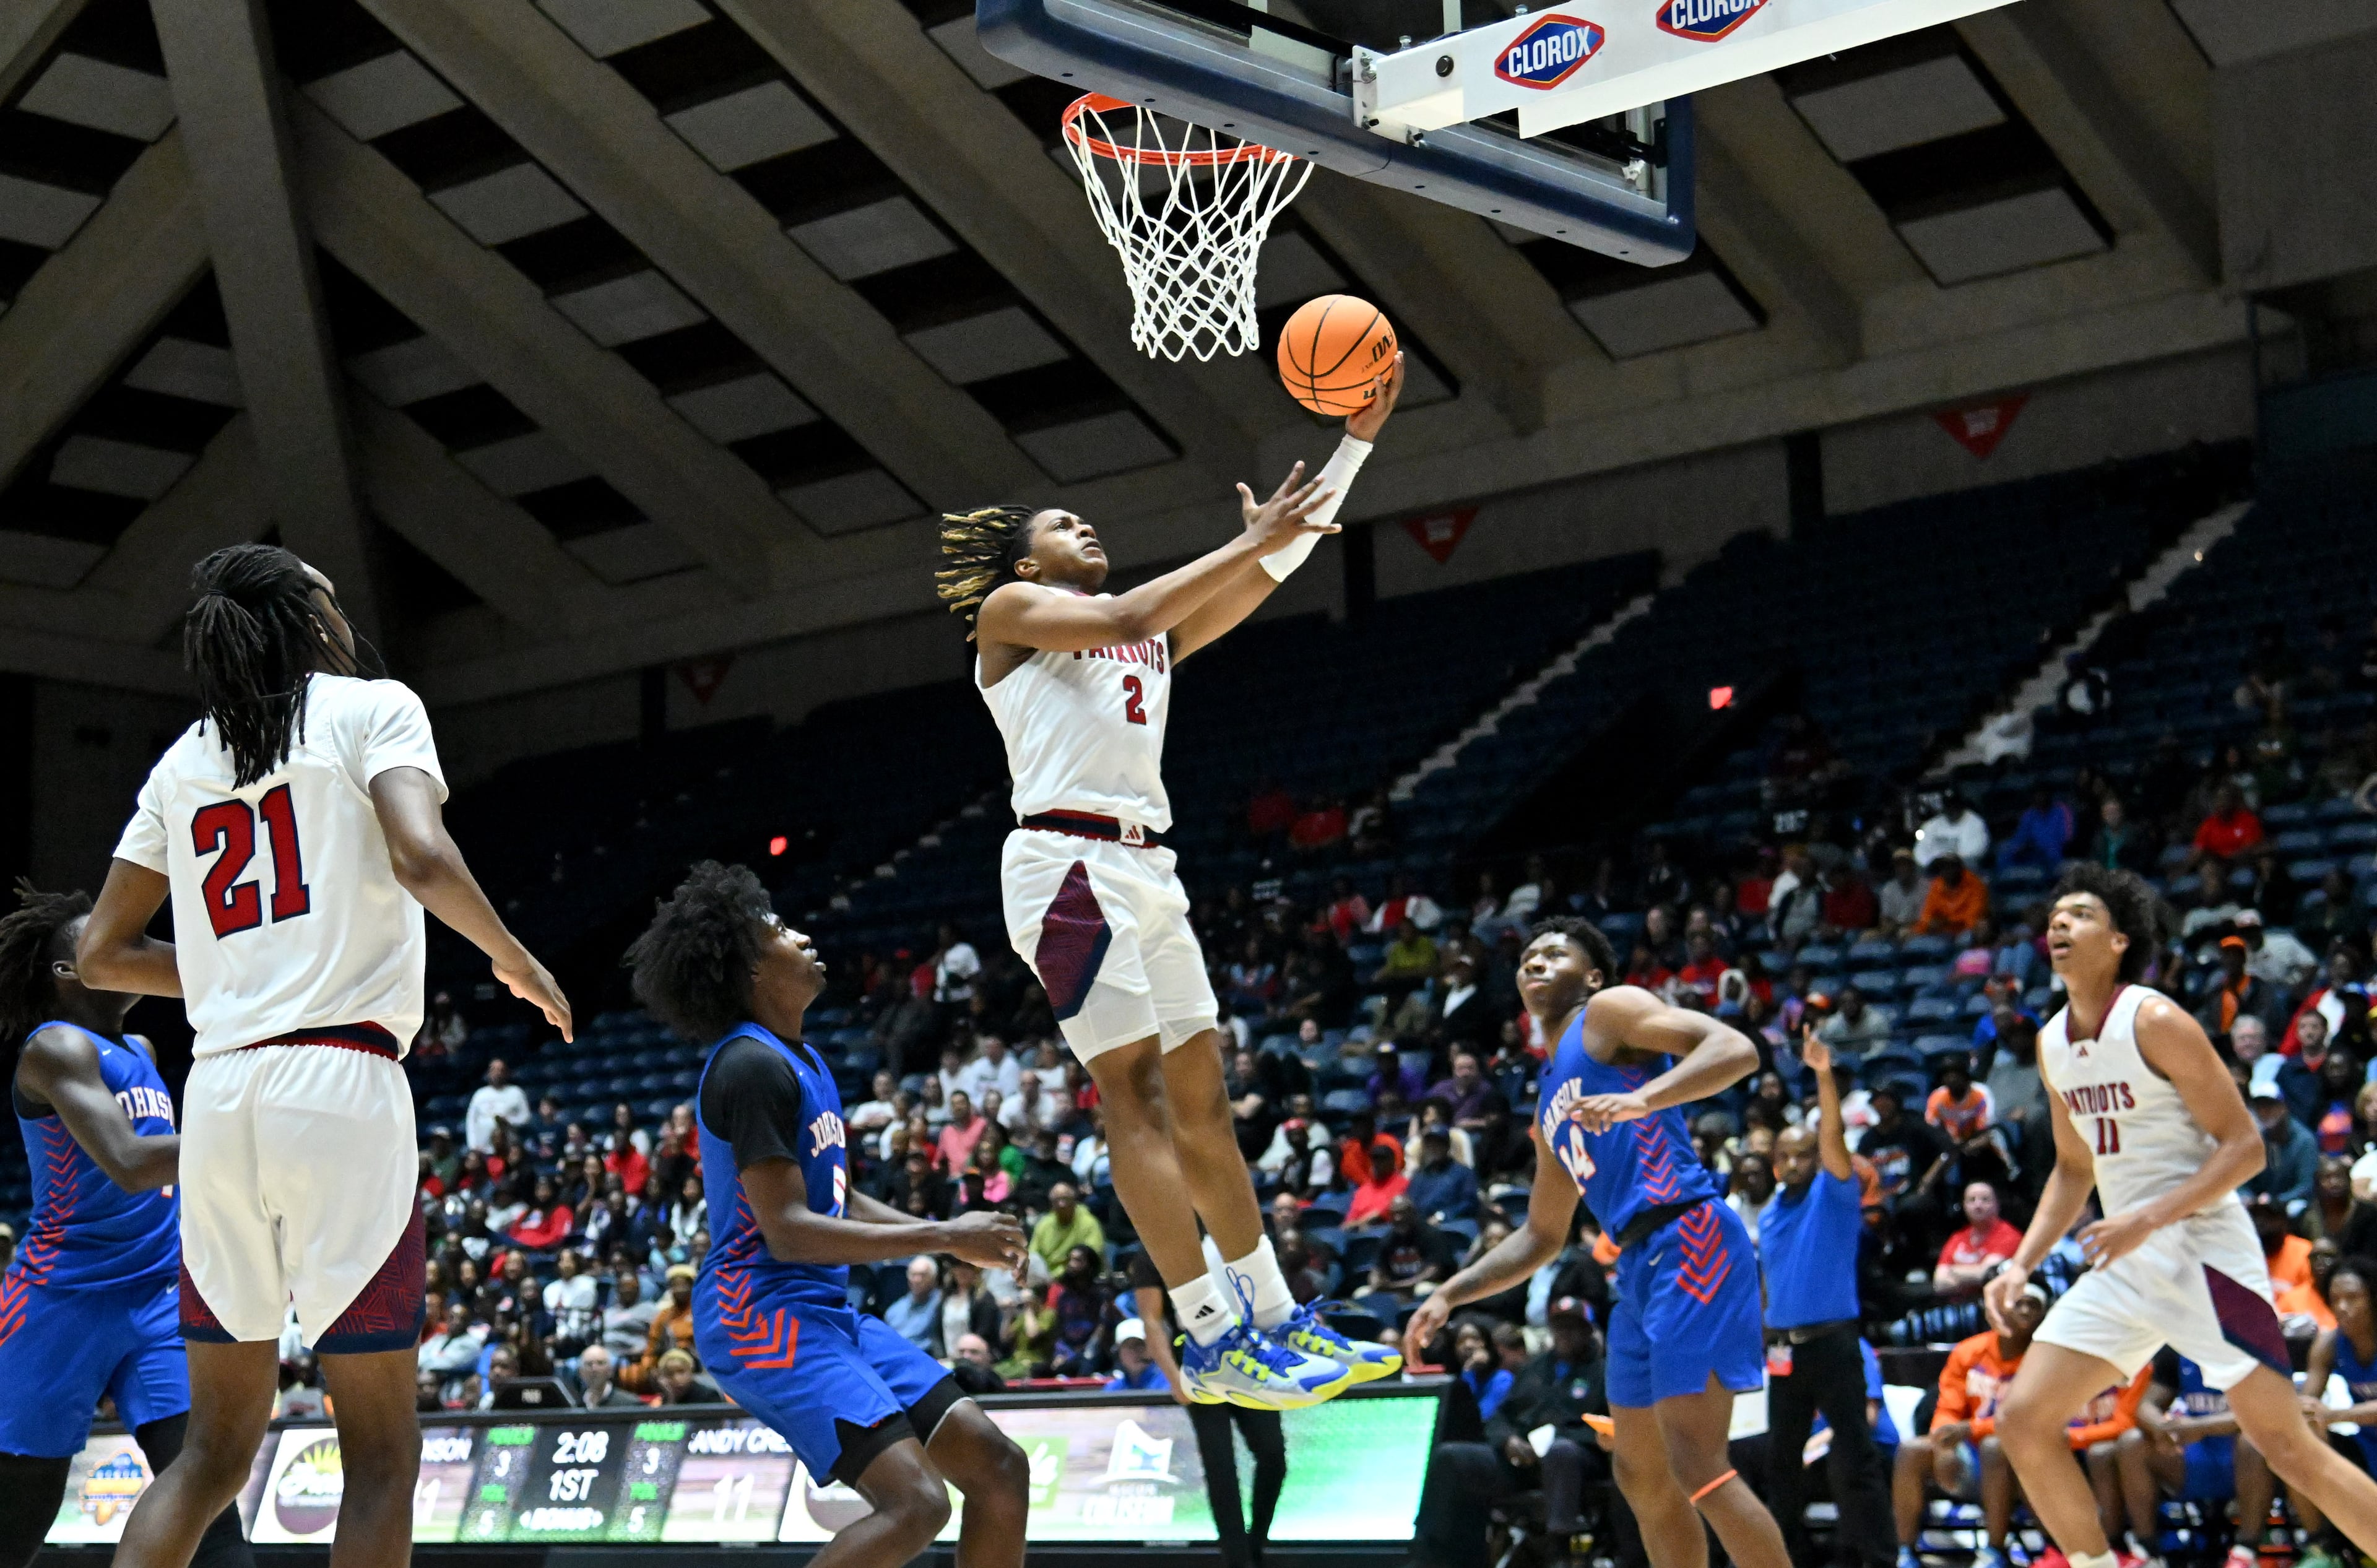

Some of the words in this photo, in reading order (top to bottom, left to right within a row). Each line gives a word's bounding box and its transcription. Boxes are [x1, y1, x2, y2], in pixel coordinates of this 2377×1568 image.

[1672, 0, 1760, 30] CLOR
[1509, 26, 1591, 78] CLOROX
[1073, 638, 1164, 675] RIOTS
[1122, 674, 1146, 725] 2
[190, 782, 311, 942] 21
[115, 1086, 173, 1127] OHNS
[1559, 1123, 1597, 1197] 14
[421, 1437, 472, 1462] NSON
[552, 1431, 609, 1463] 2:08
[688, 1428, 748, 1454] ANDY
[747, 1427, 794, 1453] CRE
[549, 1468, 599, 1501] 1ST
[713, 1473, 755, 1523] 11
